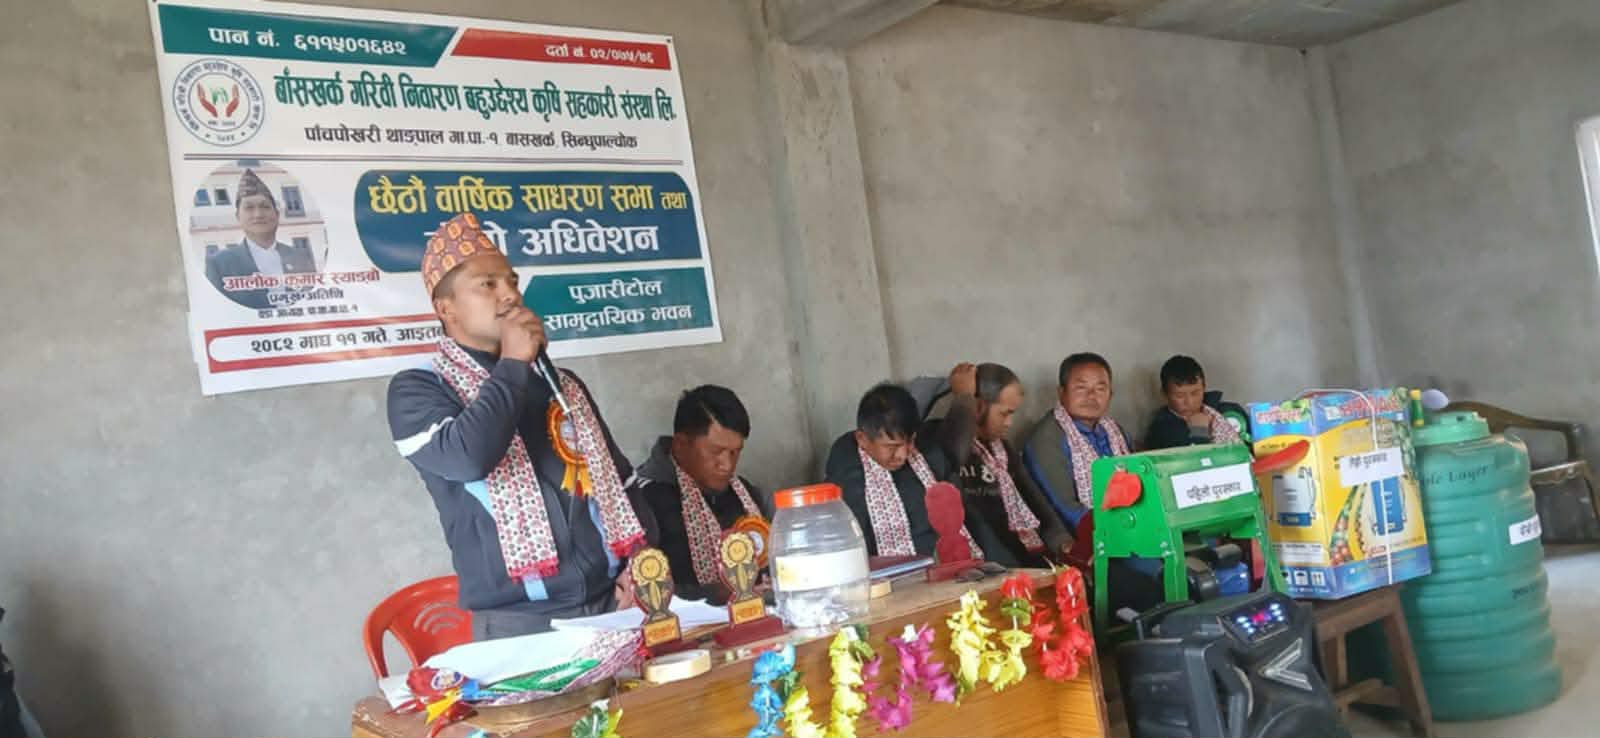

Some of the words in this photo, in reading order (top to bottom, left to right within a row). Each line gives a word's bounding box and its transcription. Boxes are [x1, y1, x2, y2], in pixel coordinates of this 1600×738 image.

[208, 27, 248, 46] पान
[256, 28, 280, 47] नं.
[294, 34, 406, 56] ६११५०१६४२
[545, 43, 569, 57] दर्ता
[398, 72, 462, 111] निवारण
[530, 80, 563, 122] कृषि
[564, 85, 618, 118] सहकारी
[619, 89, 655, 120] संस्था
[434, 175, 514, 213] वार्षिक
[520, 185, 603, 213] साधरण
[609, 185, 654, 211] सभा
[660, 191, 688, 209] तथा
[518, 219, 660, 256] अधिवेशन
[224, 273, 278, 290] आलोक
[568, 276, 664, 302] पुजारीटोल
[544, 307, 644, 331] सामुदायिक
[651, 304, 693, 321] भवन
[251, 338, 294, 353] २०८२
[299, 334, 332, 349] माघ
[337, 332, 357, 346] ११
